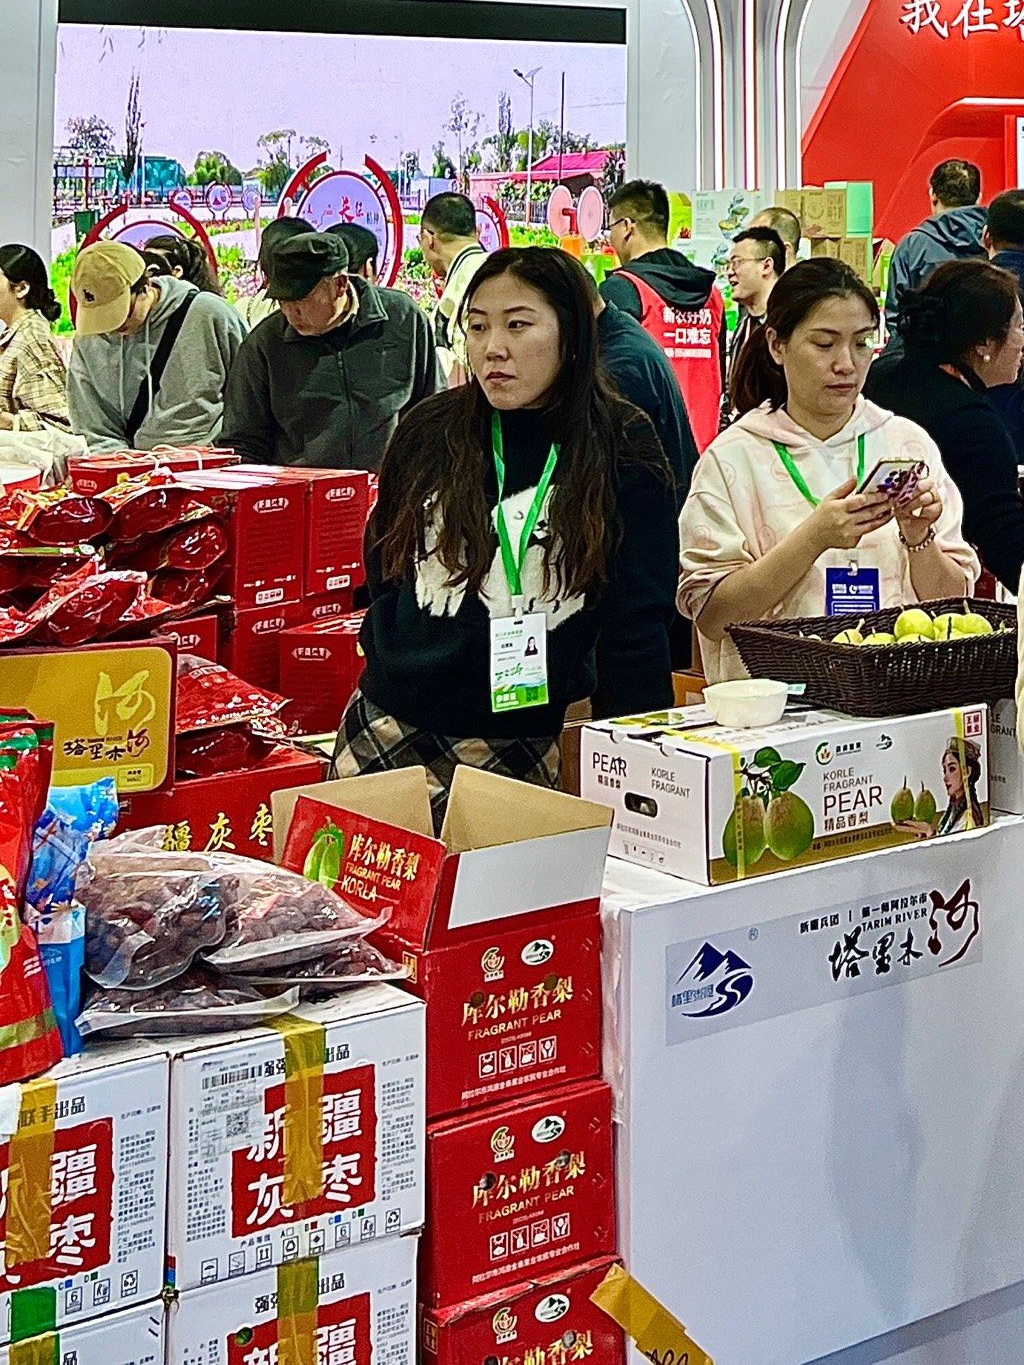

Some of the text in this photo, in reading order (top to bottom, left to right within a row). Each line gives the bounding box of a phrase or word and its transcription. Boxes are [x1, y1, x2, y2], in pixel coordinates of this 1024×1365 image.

[663, 327, 712, 345] 一口难忘
[63, 729, 150, 761] 塔里木河
[592, 751, 627, 777] PEAR
[651, 766, 675, 782] KORLE
[823, 766, 855, 782] KORLE
[651, 779, 690, 799] FRAGRANT
[823, 774, 874, 793] FRAGRANT
[823, 785, 883, 817] PEAR
[824, 810, 869, 832] 精品香梨
[348, 832, 421, 882] 库尔勒香梨
[341, 874, 377, 903] KORLA
[345, 861, 401, 891] FRAGRANT PEAR
[800, 891, 928, 934] 新疆兵团 第一师阿拉尔市
[861, 907, 928, 933] TARIM RIVER
[828, 878, 980, 982] 塔里木河
[467, 1017, 528, 1042] FRAGRANT
[532, 1009, 562, 1026] PEAR
[246, 1152, 363, 1226] 灰枣
[478, 1184, 575, 1225] FRAGRANT PEAR
